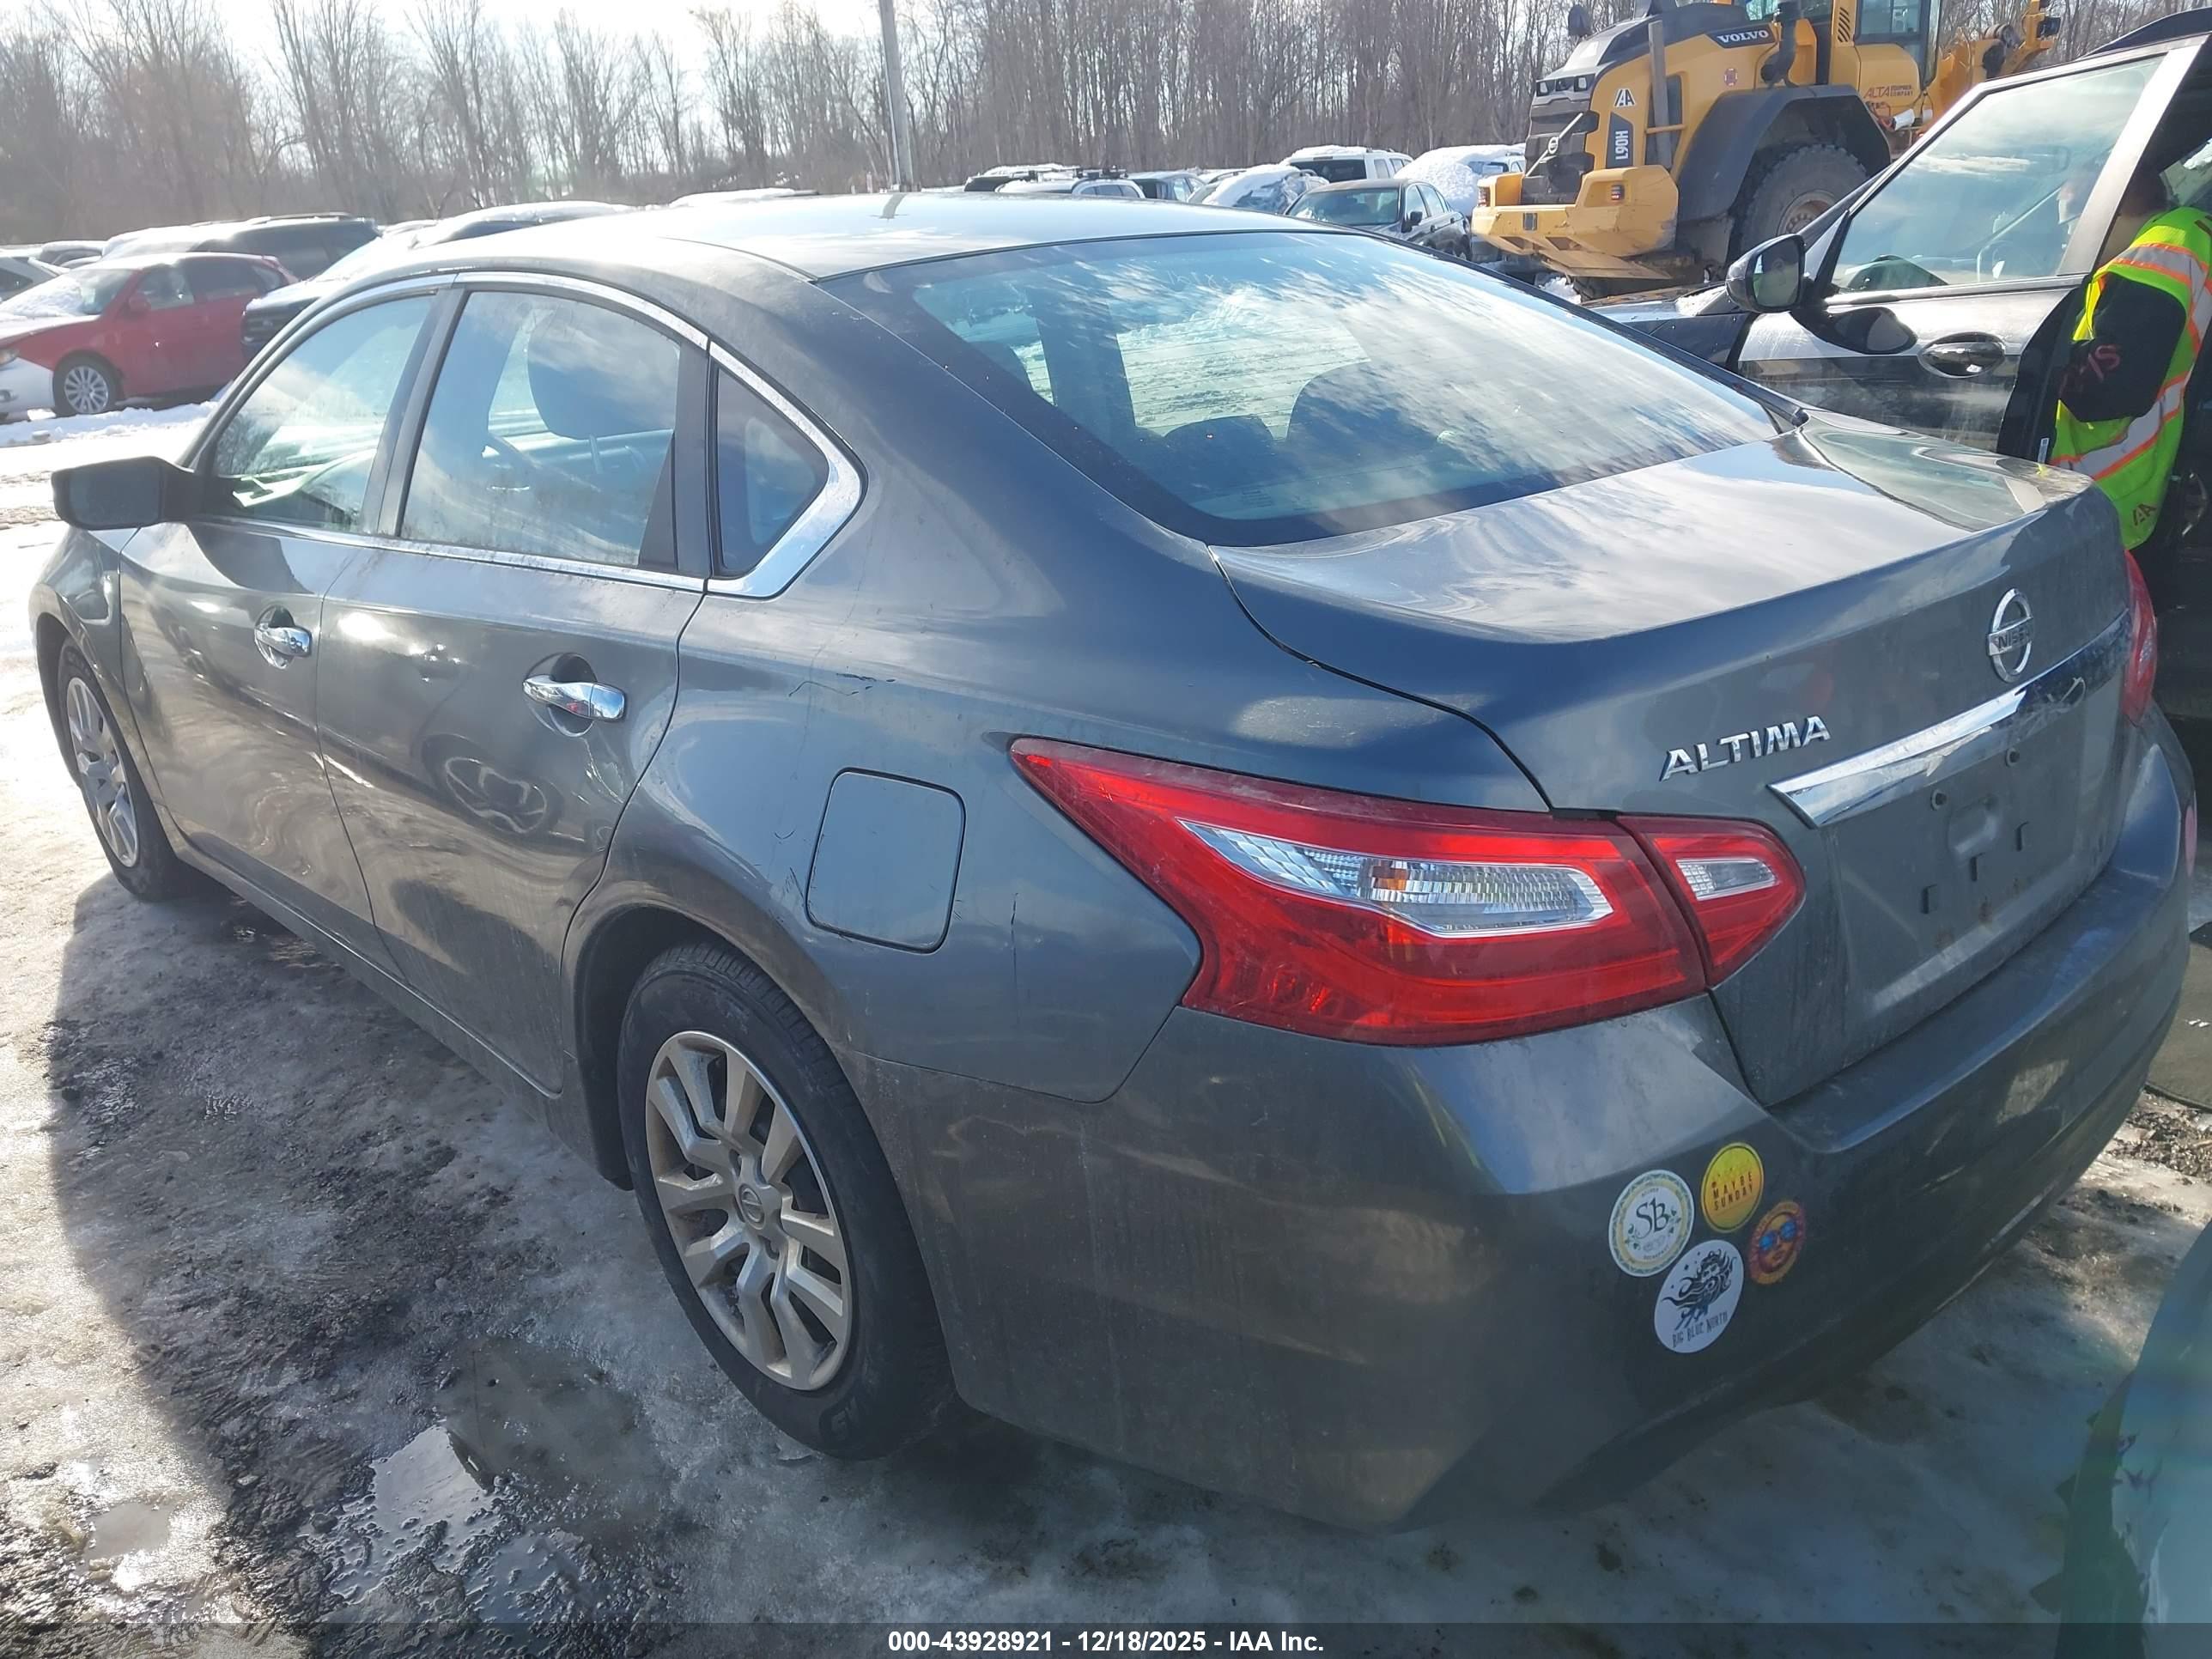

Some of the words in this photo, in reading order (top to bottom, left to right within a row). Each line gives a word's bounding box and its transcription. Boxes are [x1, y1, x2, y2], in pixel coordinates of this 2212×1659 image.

[1717, 29, 1770, 44] VOLVO
[1863, 86, 1890, 99] ALTA
[1614, 130, 1629, 161] L90H
[1998, 623, 2033, 650] NISS
[1659, 714, 1831, 782] ALTIMA
[1712, 1170, 1753, 1200] MAYBE
[1713, 1183, 1753, 1212] SUNDAY
